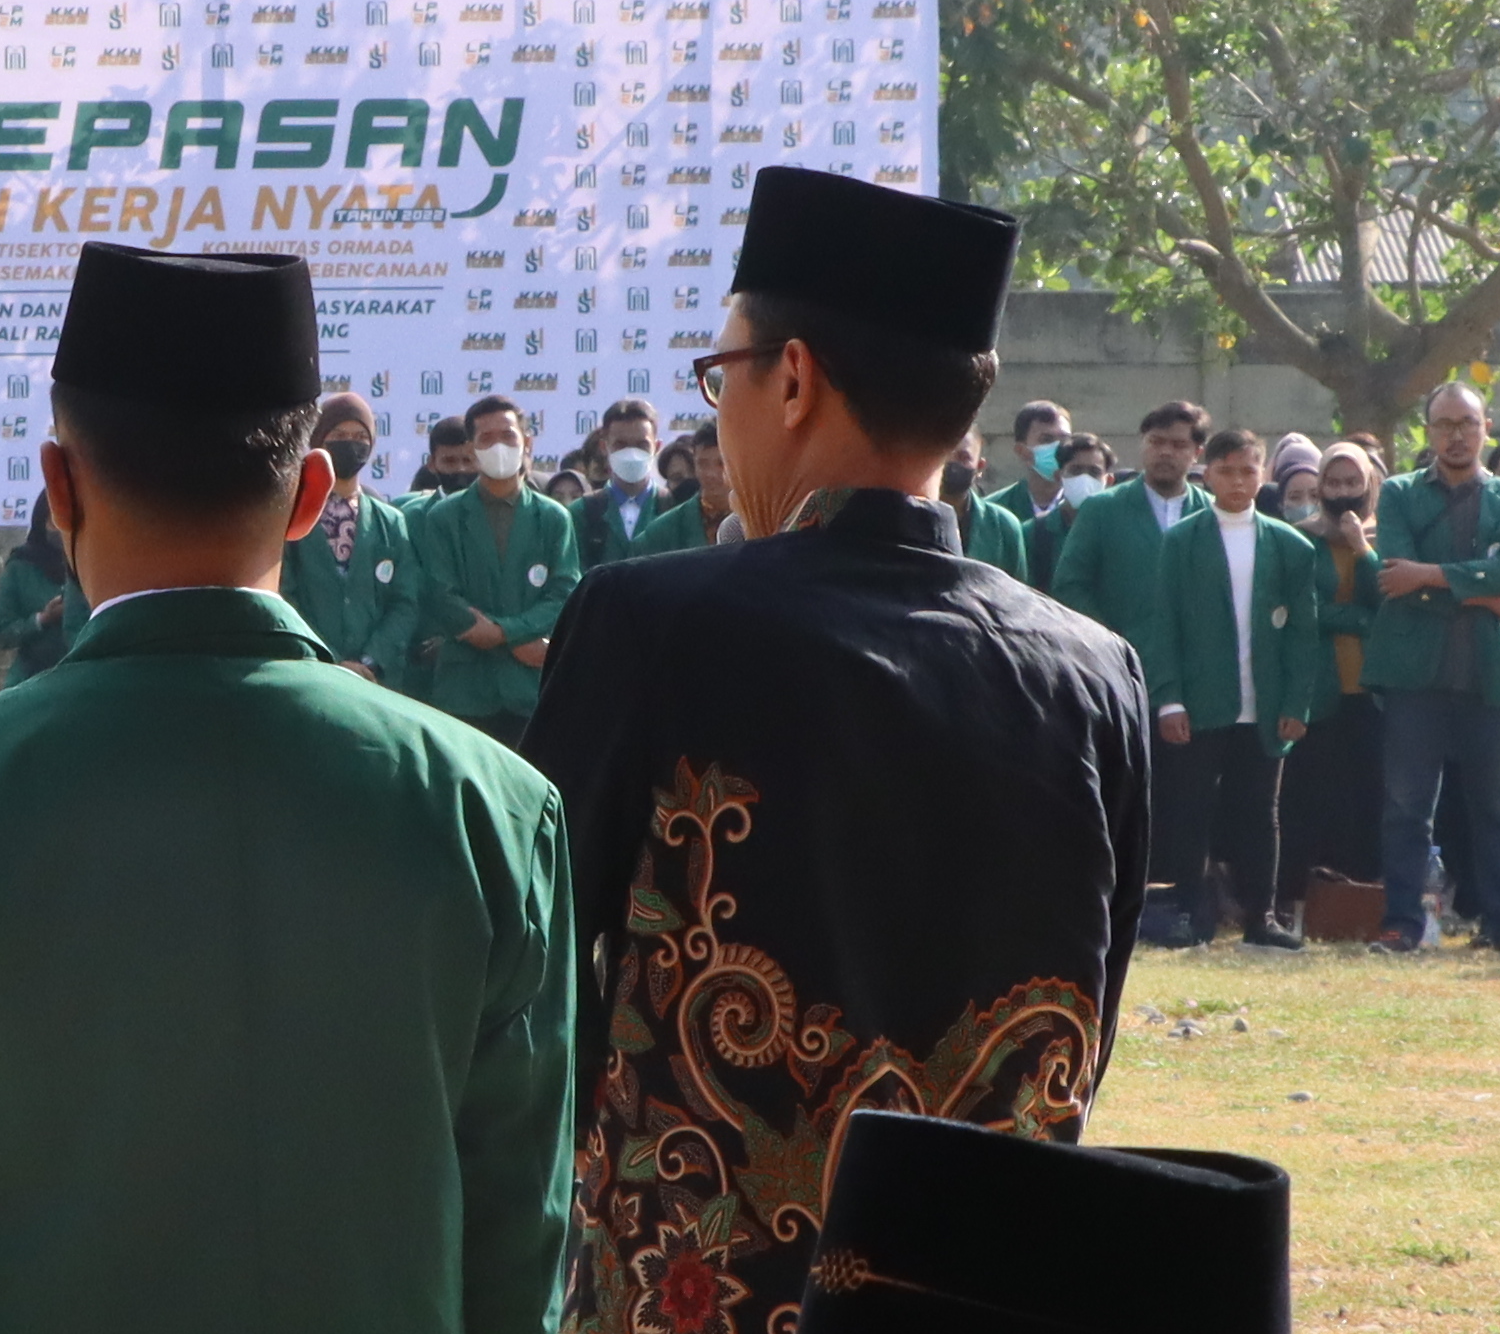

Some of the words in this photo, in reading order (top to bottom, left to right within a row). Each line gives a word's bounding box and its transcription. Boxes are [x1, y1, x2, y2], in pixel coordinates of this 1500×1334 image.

[31, 185, 226, 249] KERJA
[250, 183, 445, 231] NYATA
[335, 209, 398, 222] TAHUN
[400, 209, 445, 222] 2022
[327, 239, 415, 255] ORMADA
[309, 262, 448, 278] EBENCANAAN
[19, 302, 64, 318] DAN
[315, 299, 436, 317] ASYARAKAT
